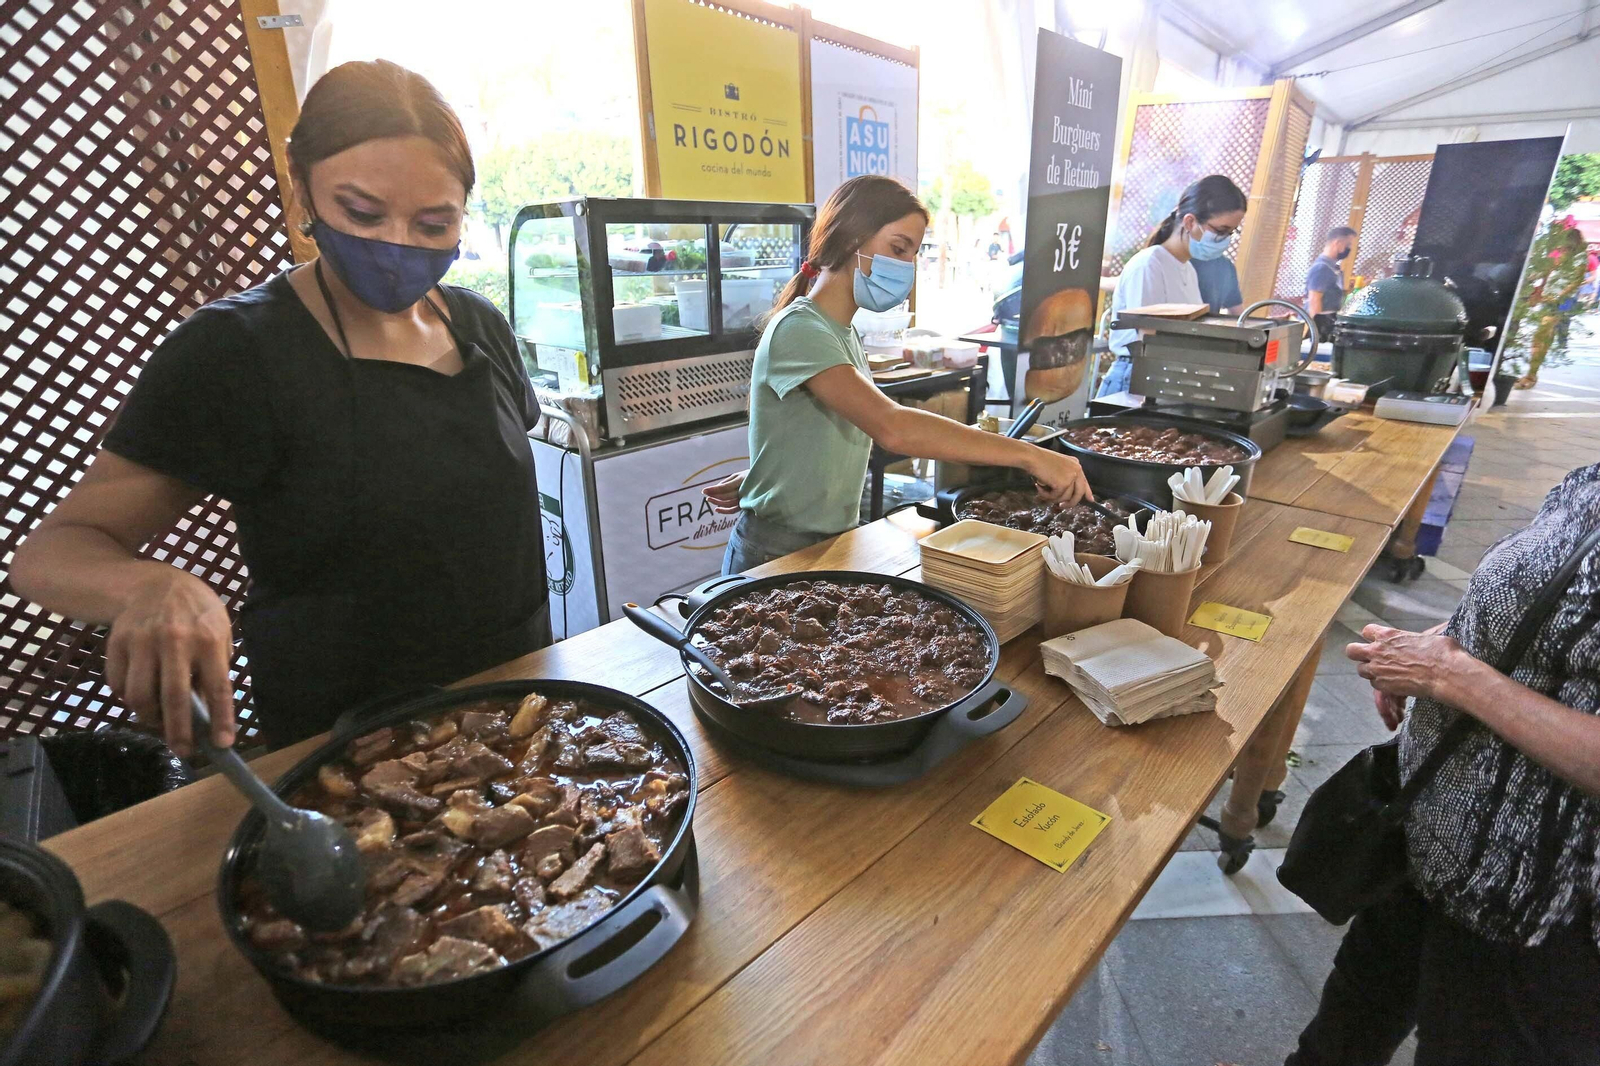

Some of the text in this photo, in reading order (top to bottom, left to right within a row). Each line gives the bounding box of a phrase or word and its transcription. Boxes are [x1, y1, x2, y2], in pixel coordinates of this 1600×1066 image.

[1067, 77, 1093, 110] Mini
[709, 107, 757, 121] BISTRÓ
[673, 123, 789, 158] RIGODÓN
[849, 122, 888, 149] ASU
[1052, 116, 1101, 154] Burguers
[701, 162, 772, 178] cocina del mundo
[1046, 155, 1100, 189] de Retinto
[1053, 223, 1082, 272] 3€
[658, 496, 714, 533] FRA
